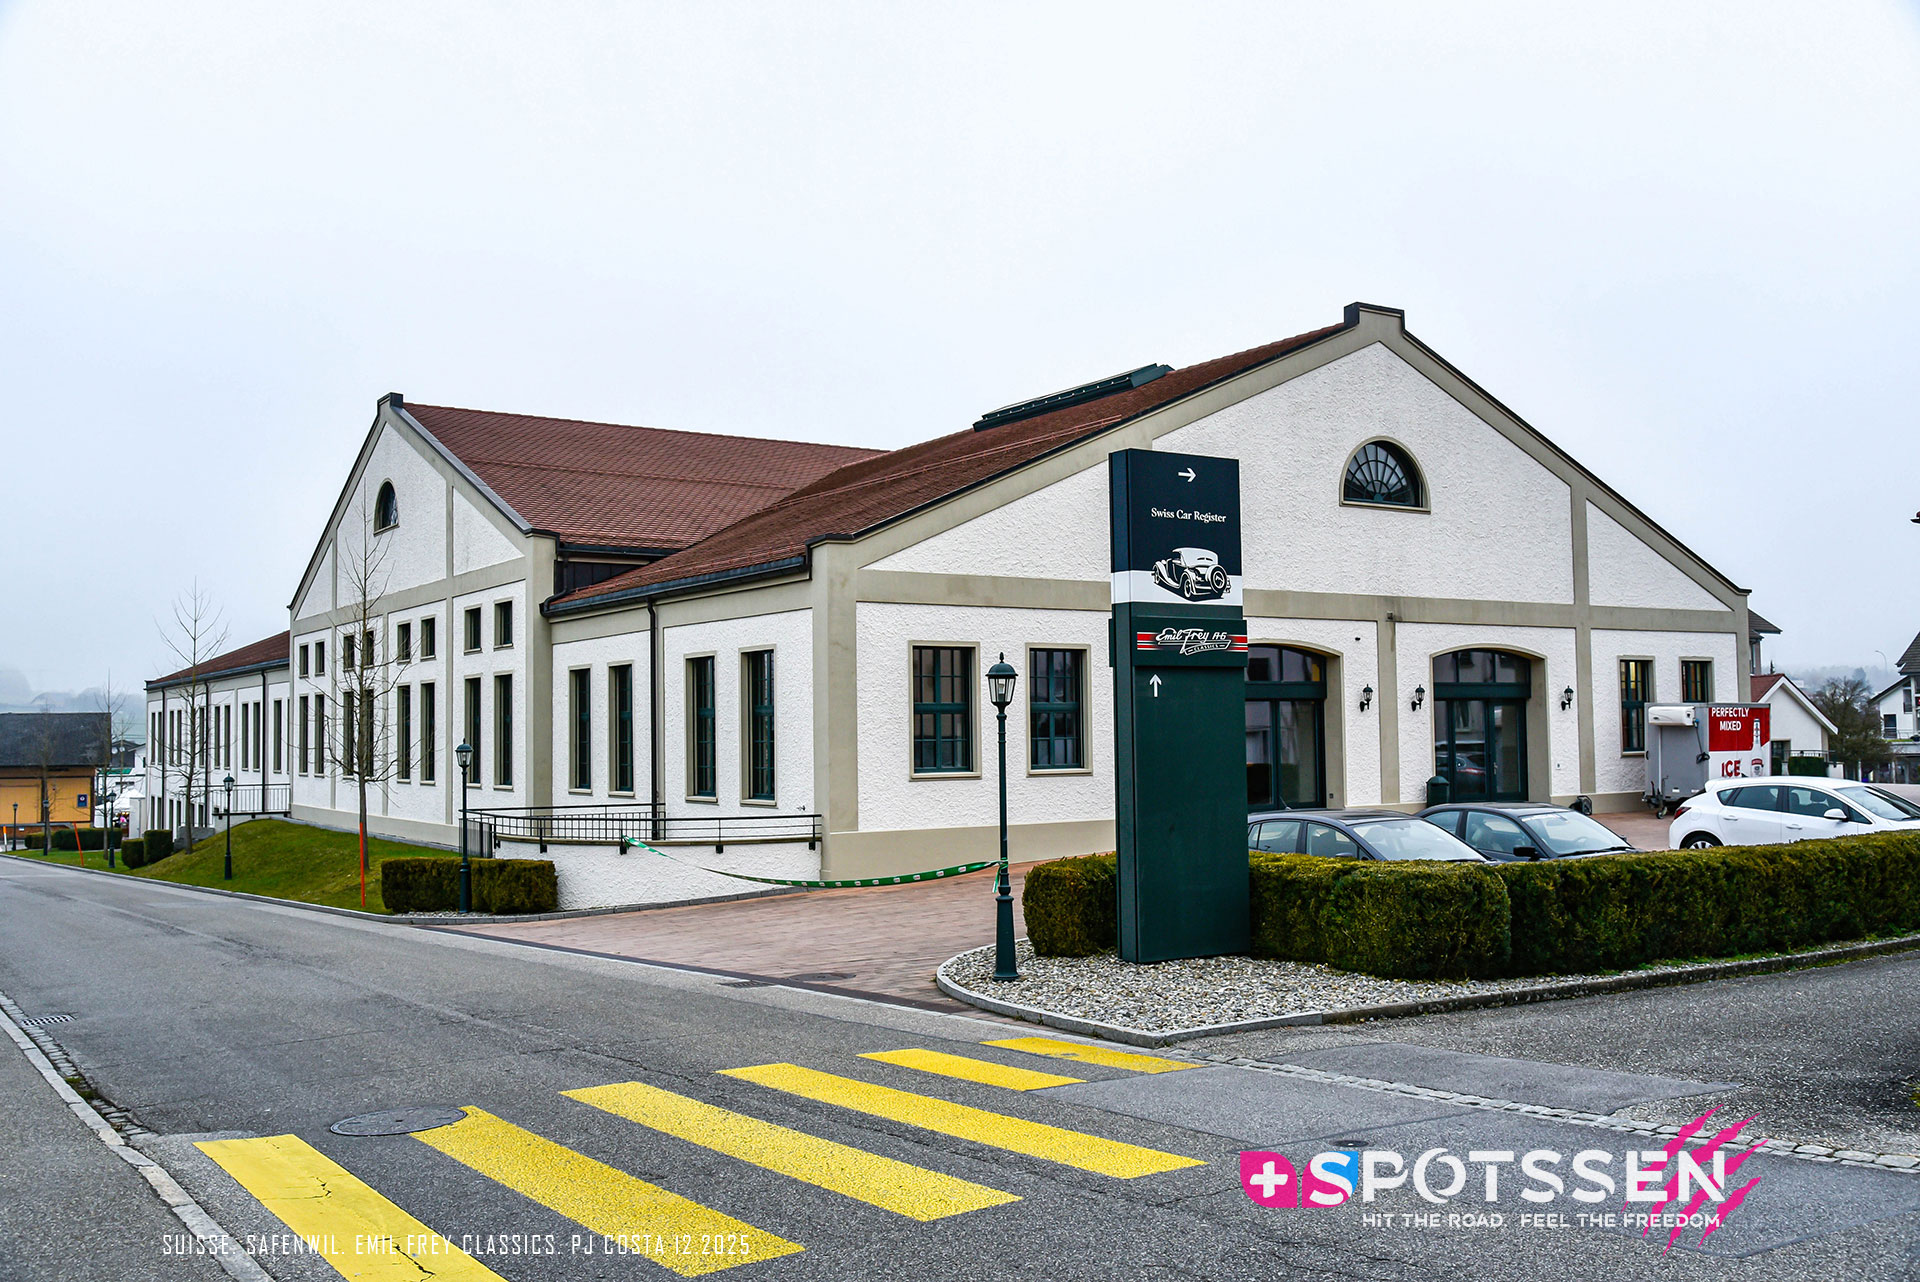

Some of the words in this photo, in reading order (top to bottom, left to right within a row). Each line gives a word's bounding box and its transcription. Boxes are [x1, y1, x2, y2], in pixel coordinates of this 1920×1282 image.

[1151, 507, 1175, 519] Swiss
[1176, 509, 1192, 520] Car
[1194, 510, 1227, 524] Register
[1155, 627, 1183, 641] Emil
[1180, 628, 1209, 654] Frey
[1711, 707, 1750, 718] PERFECTLY
[1720, 720, 1742, 731] MIXED
[1721, 759, 1742, 777] ICE
